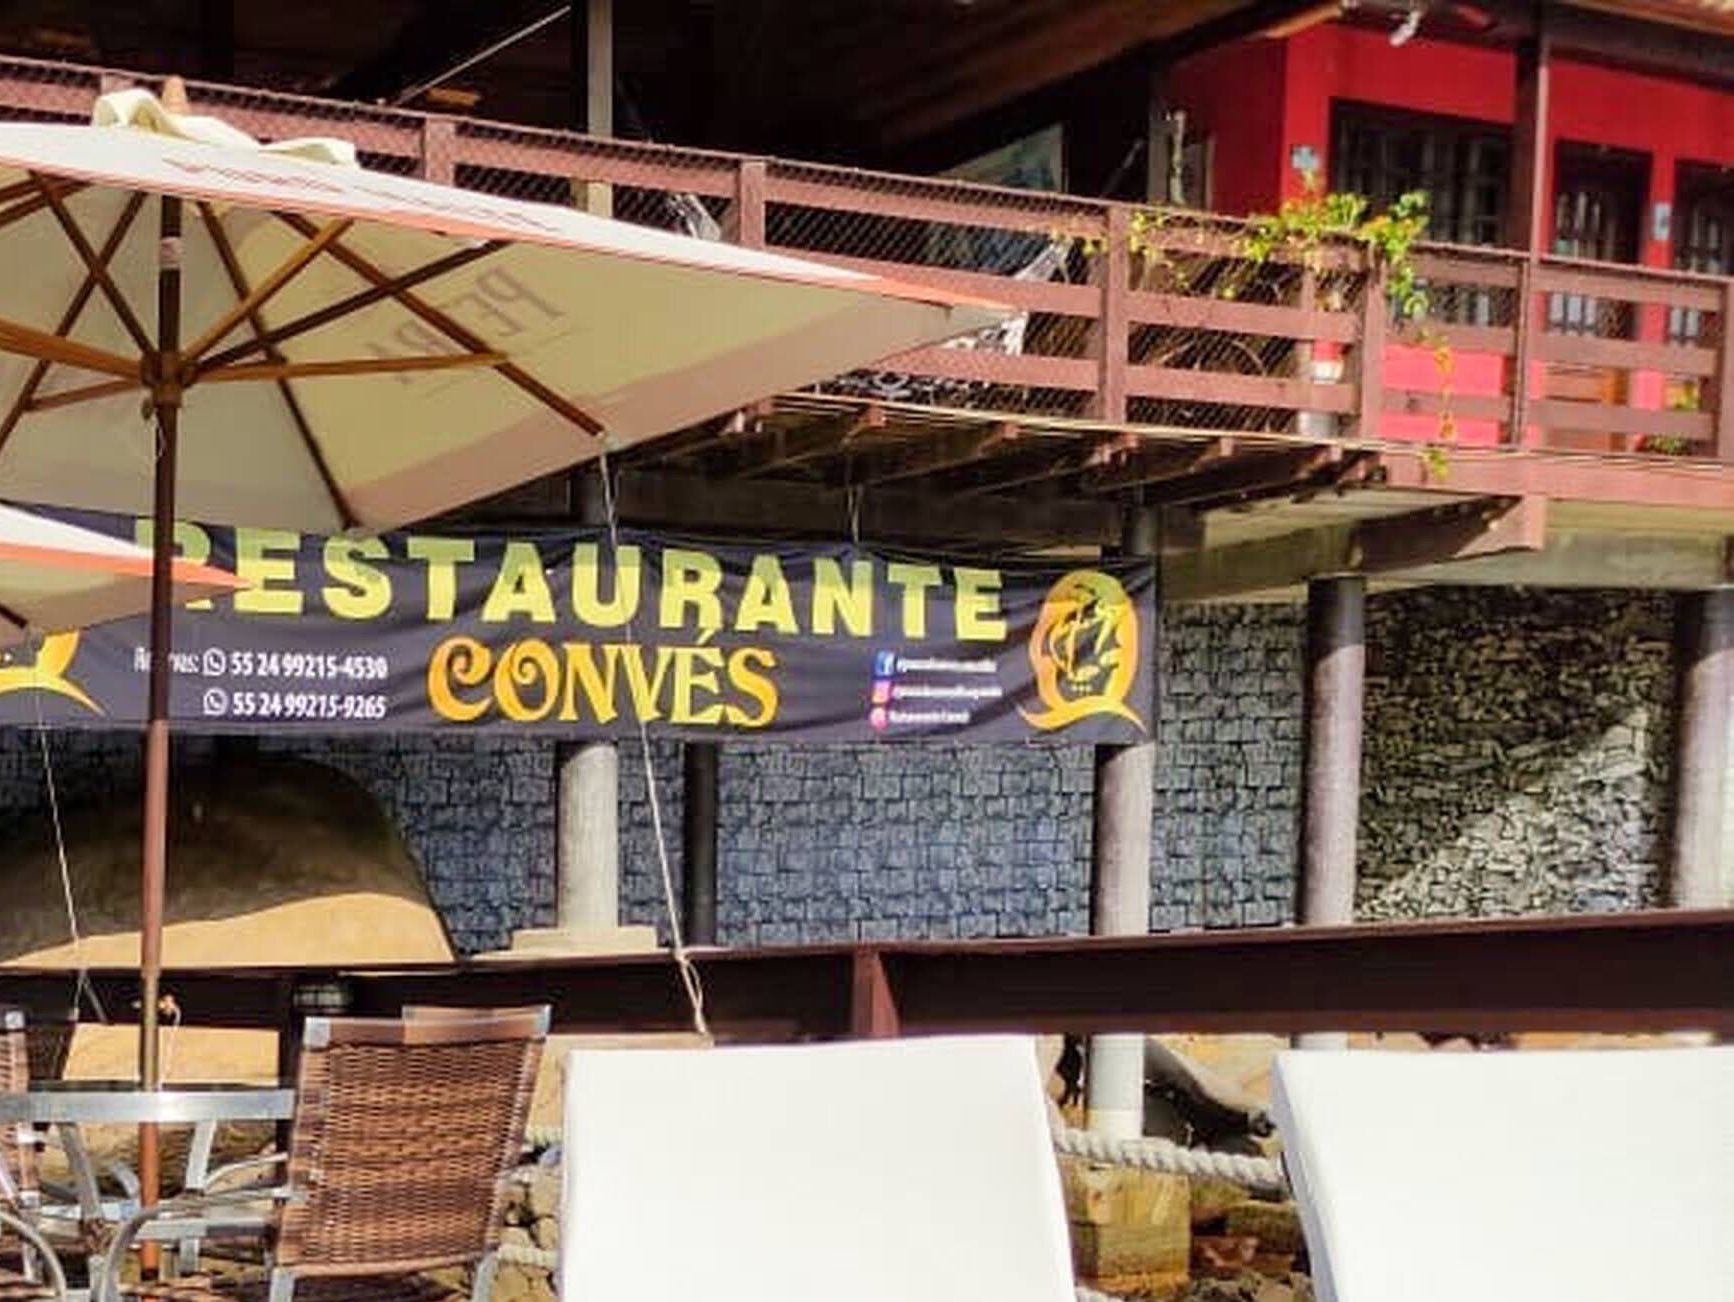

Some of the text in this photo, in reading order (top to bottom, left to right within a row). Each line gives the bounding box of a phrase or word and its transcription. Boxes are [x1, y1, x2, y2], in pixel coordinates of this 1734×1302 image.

[230, 650, 254, 677] 55
[256, 653, 280, 677] 24
[426, 627, 780, 728] CONVÉS
[232, 691, 256, 717] 55
[257, 693, 281, 718] 24
